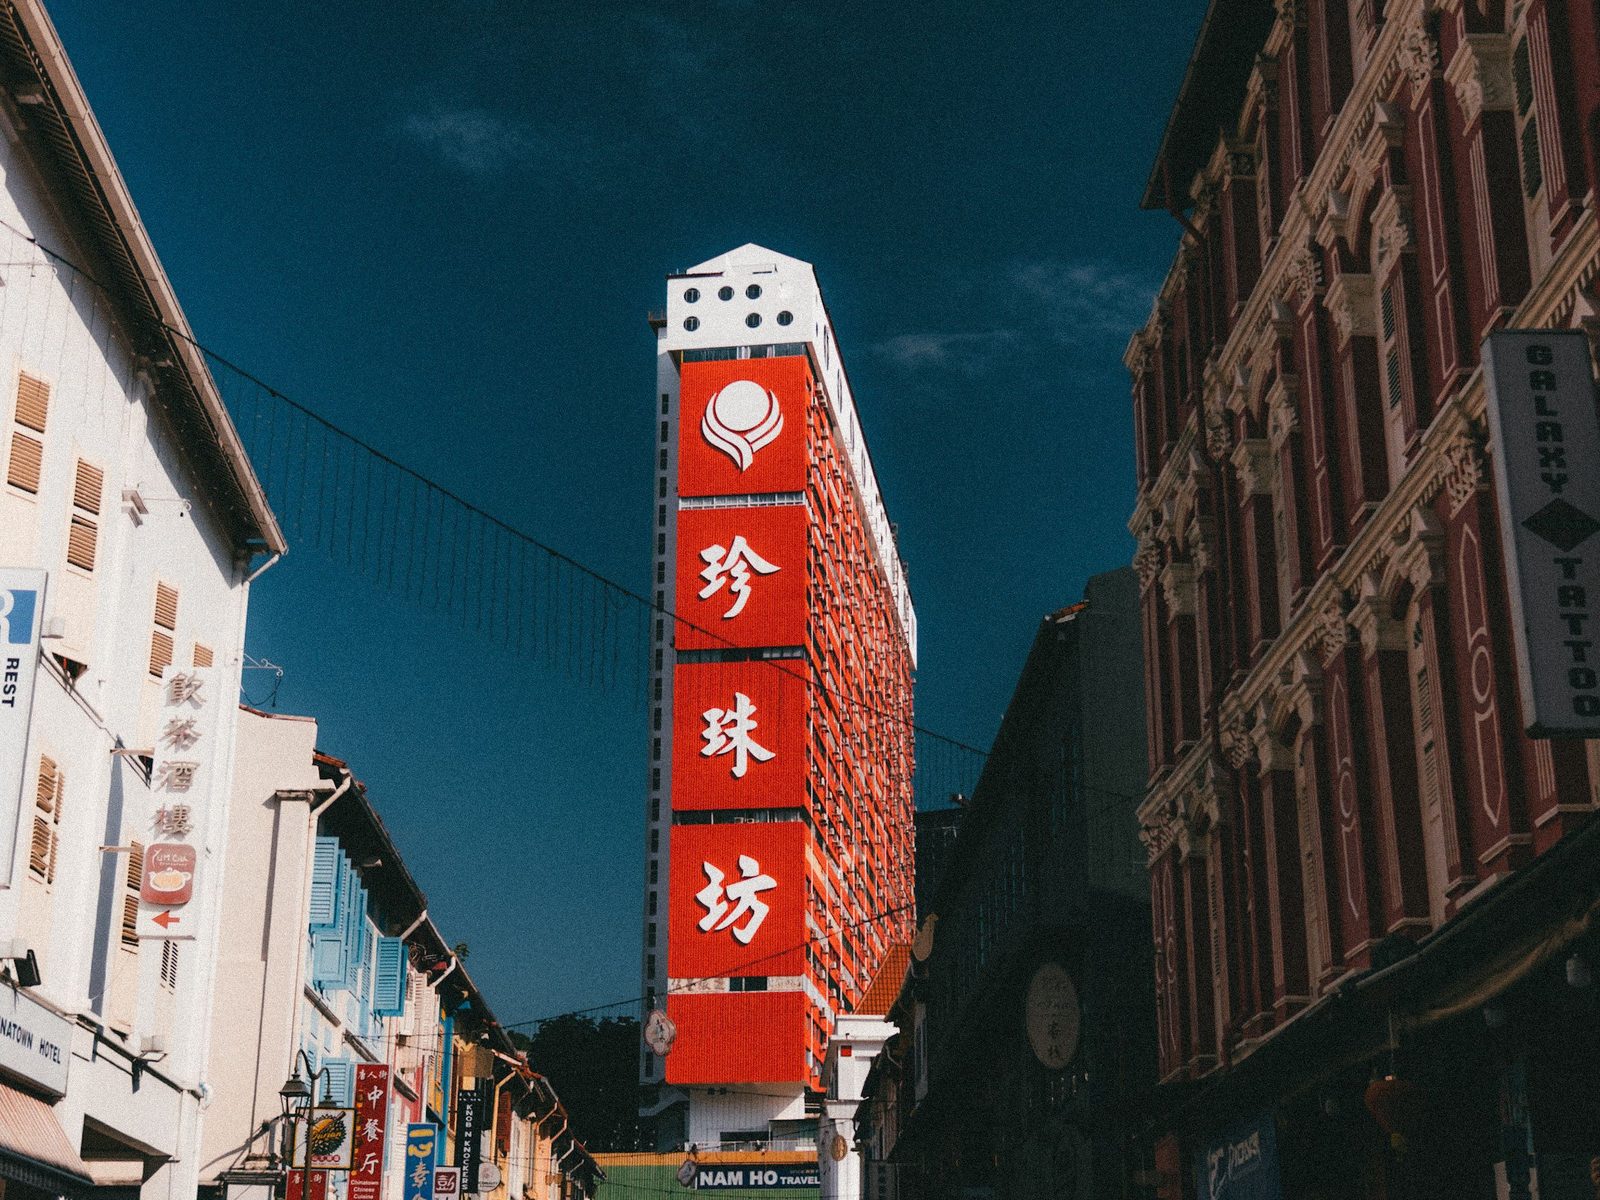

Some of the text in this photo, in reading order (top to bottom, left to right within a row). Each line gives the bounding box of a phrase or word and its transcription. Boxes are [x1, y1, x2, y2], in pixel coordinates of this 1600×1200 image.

[1525, 344, 1569, 494] GALAXY
[1553, 556, 1600, 718] TATTOO
[1, 657, 20, 708] REST
[148, 670, 207, 838] 飲茶酒樓
[695, 535, 782, 945] 珍珠坊
[39, 1037, 61, 1065] HOTEL
[359, 1085, 384, 1175] 中餐厅
[465, 1103, 473, 1128] KNOB
[292, 1173, 322, 1184] 唐街
[407, 1128, 434, 1200] 一心素
[461, 1140, 471, 1190] KNOCKERS
[700, 1170, 820, 1186] NAM HO TRAVEL
